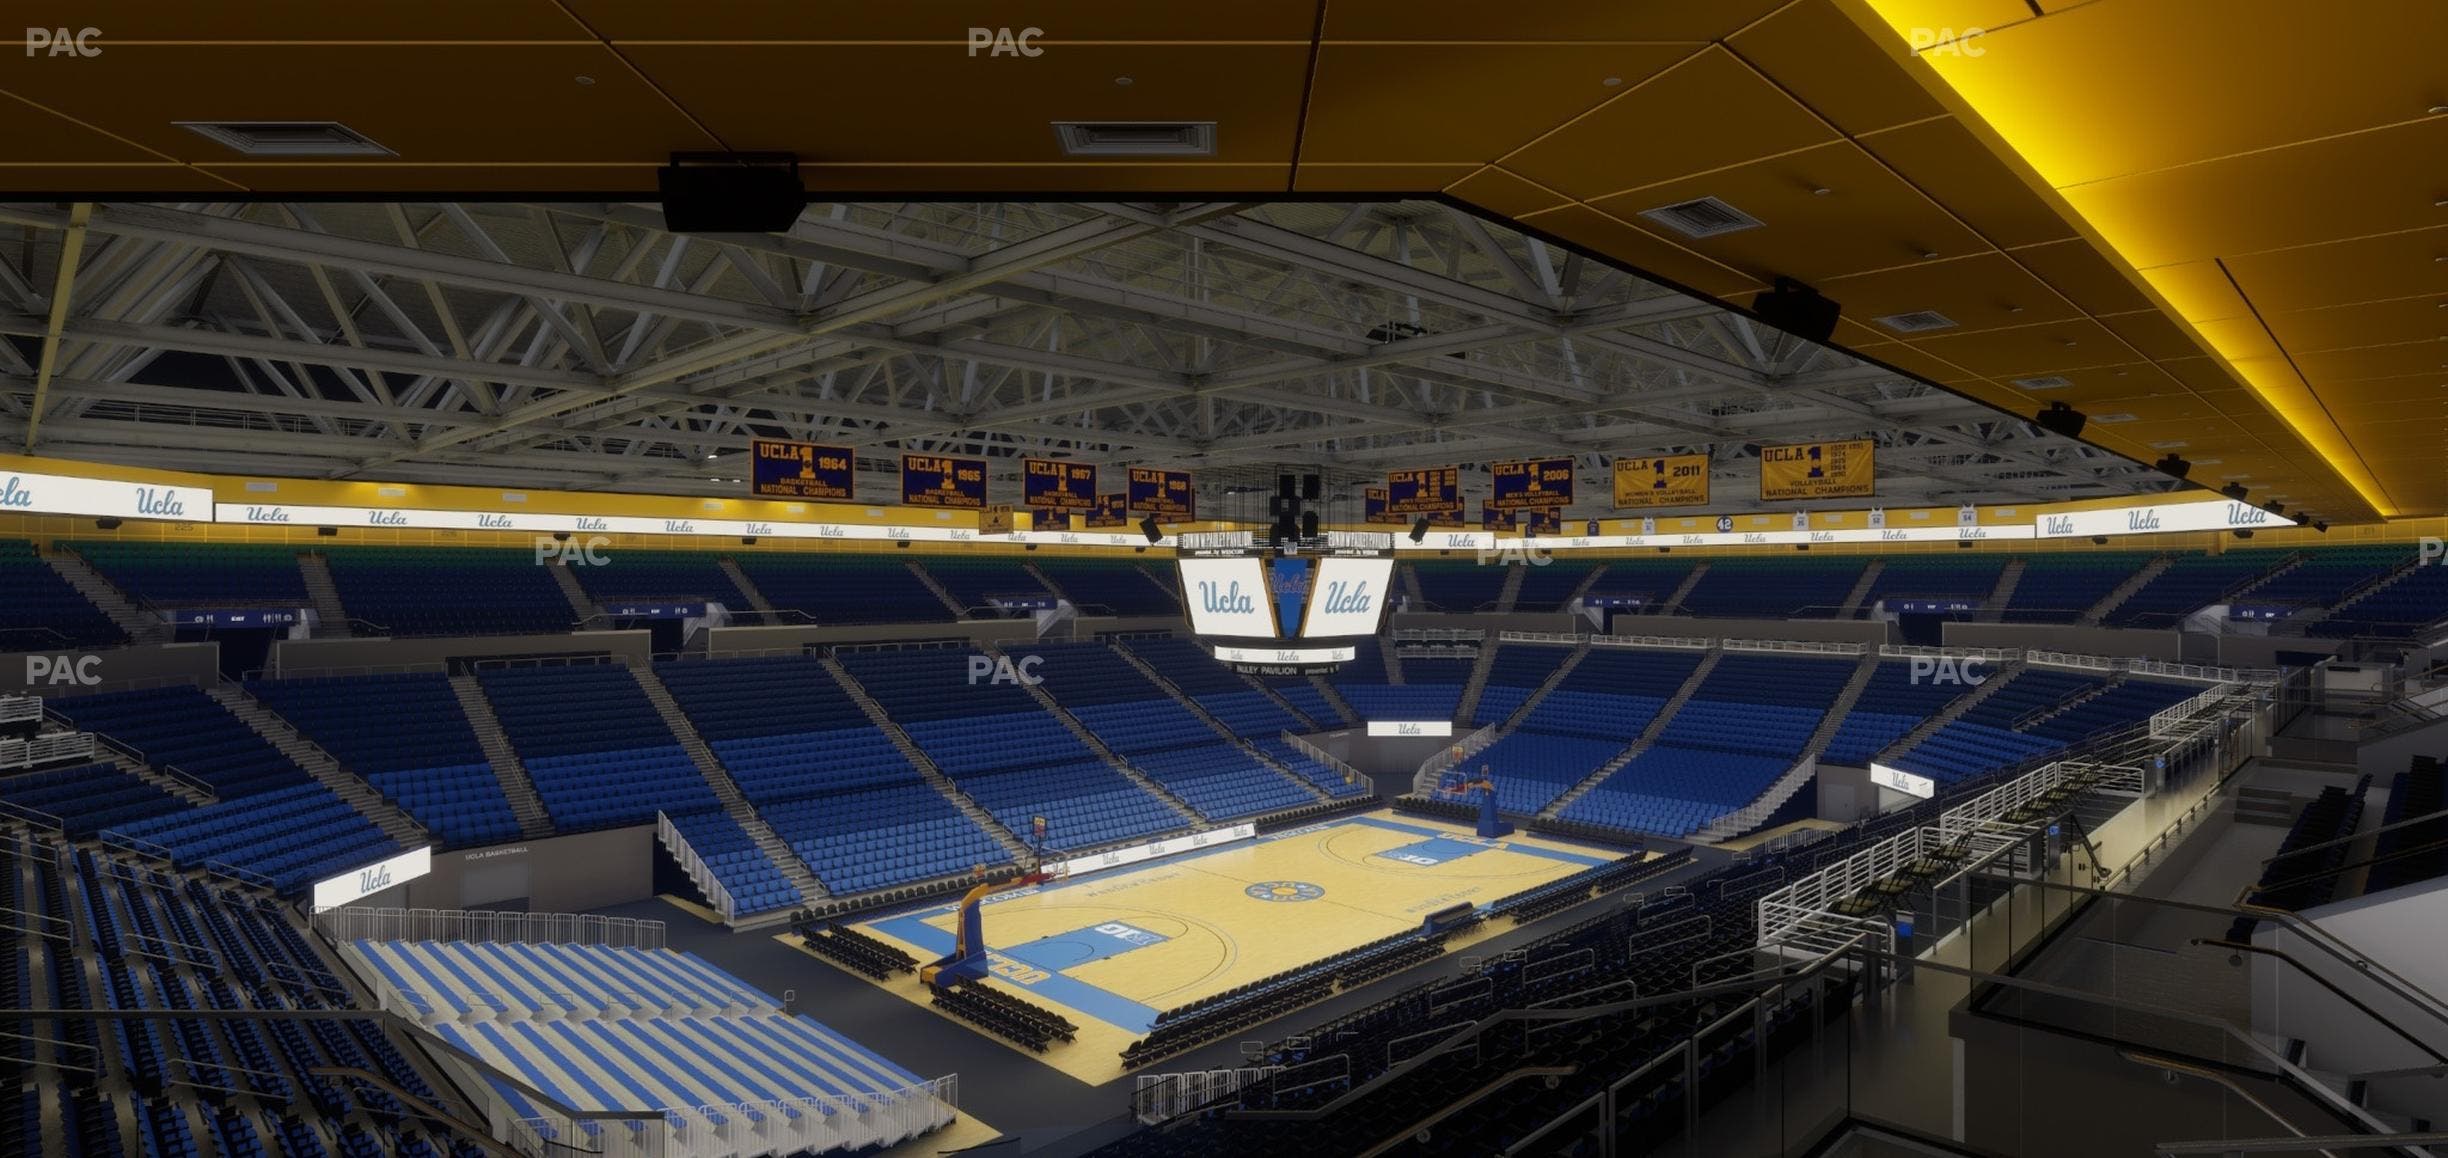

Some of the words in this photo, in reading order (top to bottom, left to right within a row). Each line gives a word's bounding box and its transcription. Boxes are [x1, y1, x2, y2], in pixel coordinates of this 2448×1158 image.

[760, 443, 799, 460] UCLA
[800, 446, 816, 479] 1
[819, 457, 848, 470] 1964
[1764, 448, 1804, 462] UCLA
[1808, 446, 1824, 478] 1
[908, 457, 941, 472] UCLA
[942, 460, 955, 490] 1
[958, 469, 981, 481] 1965
[1029, 462, 1057, 475] UCLA
[1058, 464, 1067, 491] 1
[1133, 470, 1157, 483] UCLA
[1495, 464, 1524, 475] UCLA
[1528, 464, 1540, 491] 1
[1543, 469, 1569, 481] 2006
[1616, 461, 1649, 472] UCLA
[1653, 460, 1666, 489] 1
[1673, 465, 1700, 477] 2011
[761, 483, 797, 495] NATIONAL
[803, 486, 846, 497] CHAMPIONS
[1390, 472, 1414, 483] UCLA
[1417, 471, 1428, 498] 1
[1790, 479, 1836, 487] VOLLEYBALL
[0, 476, 32, 507] la
[1767, 488, 1807, 497] NATIONAL
[1815, 484, 1869, 494] CHAMPIONS
[137, 487, 184, 516] Ucla
[909, 494, 941, 504] NATIONAL
[944, 496, 981, 506] CHAMPIONS
[1497, 498, 1528, 507] NATIONAL
[1529, 495, 1569, 505] CHAMPIONS
[1618, 497, 1653, 505] NATIONAL
[1659, 495, 1704, 504] CHAMPIONS
[246, 507, 291, 522] Ucla
[369, 511, 408, 526] Ucla
[2128, 509, 2160, 530] Ucla
[2227, 503, 2267, 525] Ucla
[478, 514, 513, 529] Ucla
[576, 517, 607, 531] Ucla
[664, 520, 694, 534] Ucla
[1717, 519, 1733, 530] 42
[2047, 516, 2073, 535] Ucla
[746, 523, 772, 535] Ucla
[820, 526, 844, 537] Ucla
[888, 527, 910, 539] Ucla
[950, 530, 970, 540] Ucla
[1882, 530, 1908, 540] Ucla
[1959, 528, 1987, 539] Ucla
[1448, 534, 1475, 547] Ucla
[1683, 536, 1703, 544] Ucla
[1744, 533, 1767, 543] Ucla
[1811, 532, 1834, 541] Ucla
[1199, 581, 1255, 614] Ucla
[1325, 580, 1371, 614] Ucla
[1276, 650, 1300, 662] Ucla
[1399, 723, 1421, 735] Ucla
[465, 852, 484, 860] UCLA
[360, 864, 391, 894] Ucla
